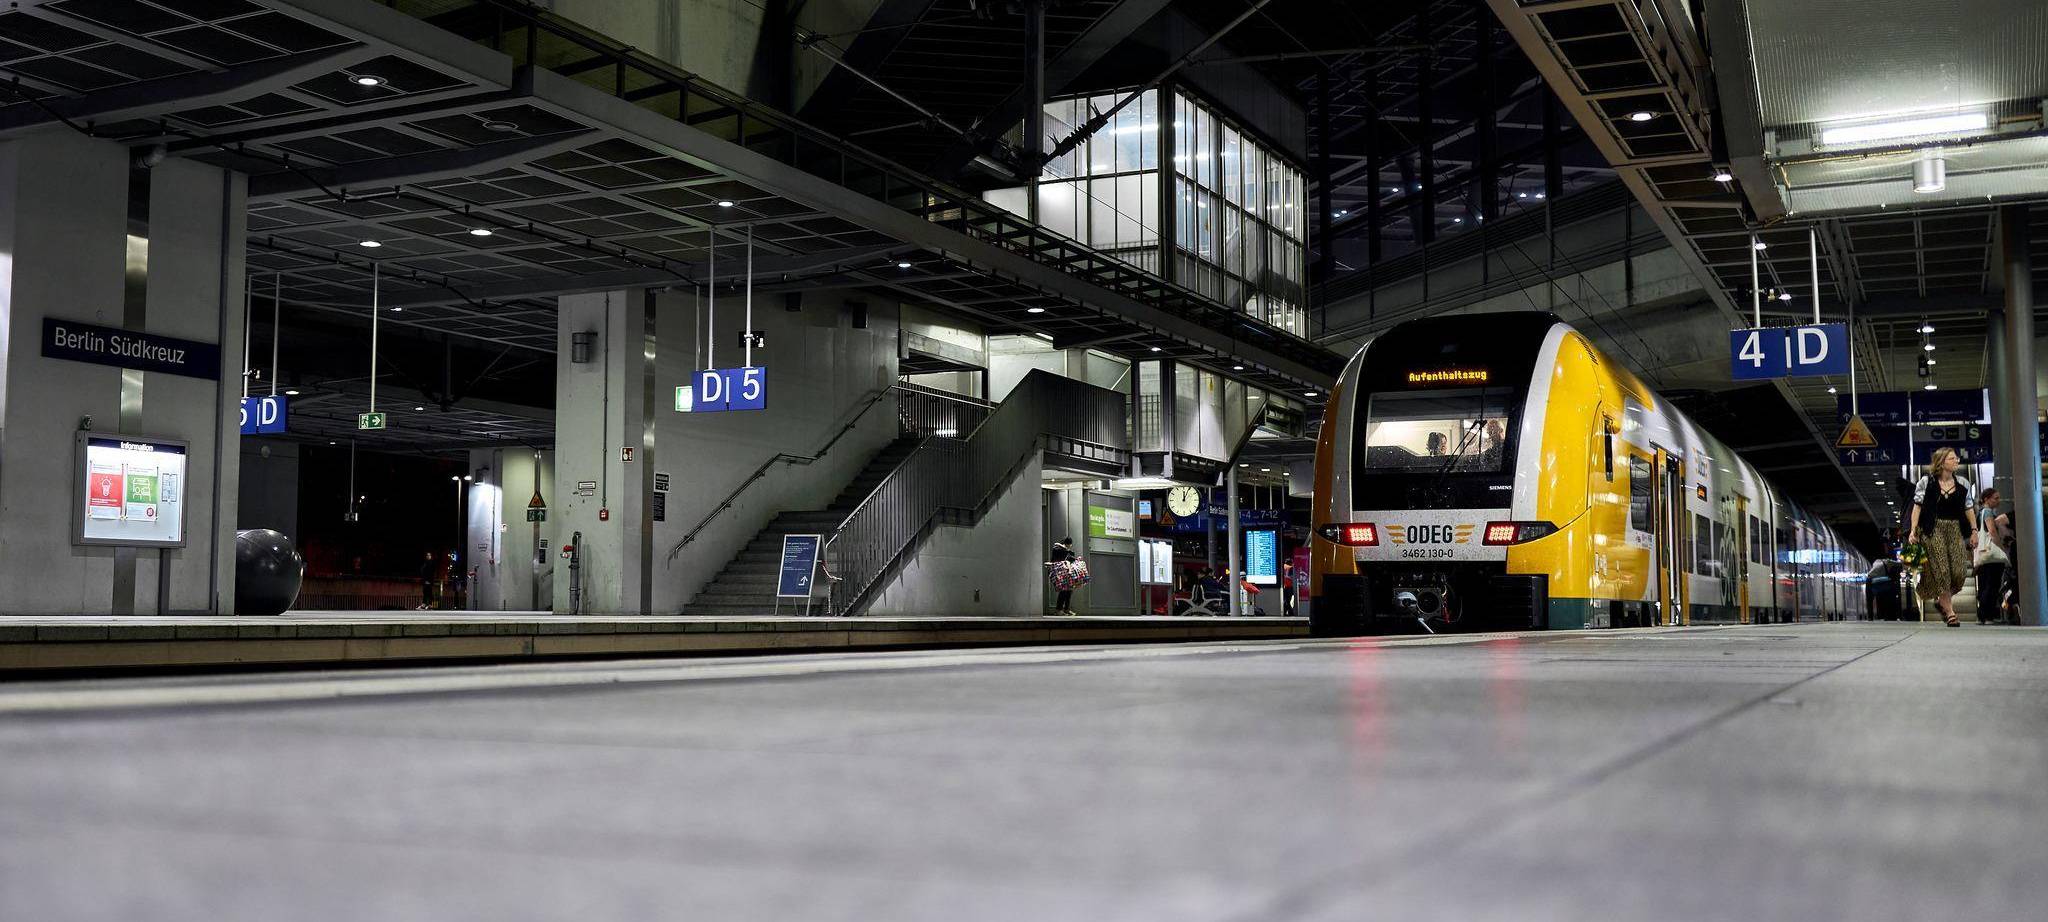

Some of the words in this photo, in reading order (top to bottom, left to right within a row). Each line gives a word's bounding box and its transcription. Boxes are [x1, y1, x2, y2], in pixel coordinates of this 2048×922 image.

[54, 327, 104, 353] Berlin
[110, 335, 185, 364] Südkreuz
[1739, 331, 1765, 368] 4
[1797, 327, 1829, 365] D
[702, 372, 722, 402] D
[742, 369, 760, 400] 5
[1409, 370, 1487, 382] Aufenthaltszug
[261, 398, 278, 425] D
[121, 441, 154, 452] Information
[1407, 524, 1453, 544] ODEG
[1402, 549, 1426, 559] 3462
[1428, 549, 1454, 558] 130-0
